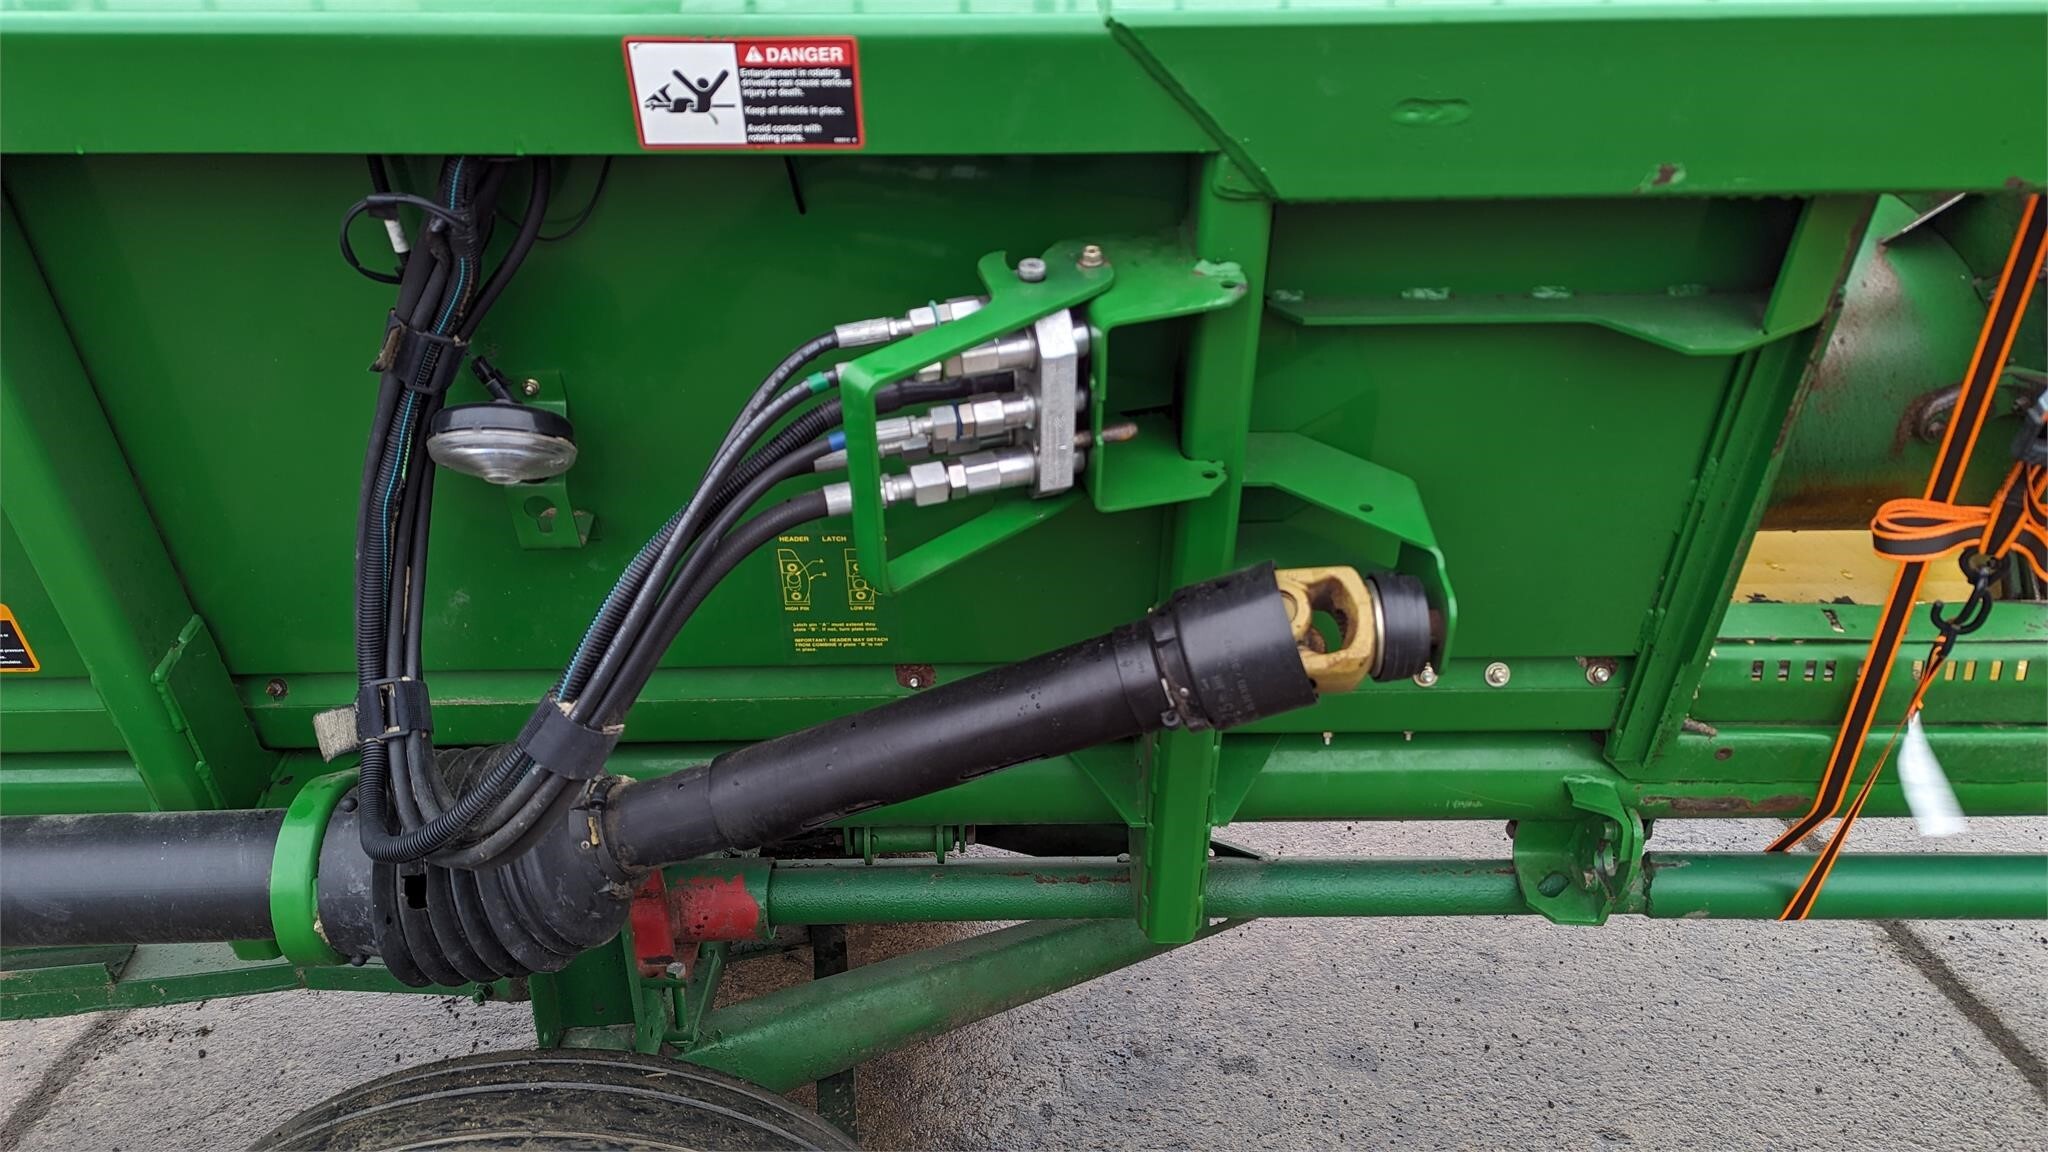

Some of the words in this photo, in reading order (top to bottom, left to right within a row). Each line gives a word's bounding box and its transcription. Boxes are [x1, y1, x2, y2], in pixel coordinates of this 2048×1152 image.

[766, 47, 844, 63] DANGER
[740, 68, 797, 79] Entanglement
[797, 68, 806, 77] in
[807, 68, 841, 79] rotating
[741, 78, 777, 88] driveline
[778, 79, 794, 88] can
[795, 79, 819, 88] cause
[820, 78, 852, 88] serious
[742, 88, 766, 99] injury
[767, 88, 777, 97] or
[778, 87, 805, 97] death.
[744, 105, 767, 117] Keep
[767, 105, 778, 115] all
[779, 105, 808, 115] shields
[809, 105, 818, 115] in
[819, 105, 844, 118] place.
[748, 123, 771, 133] Avoid
[772, 123, 803, 133] contact
[804, 123, 823, 133] with
[748, 133, 781, 144] rotating
[781, 133, 805, 144] parts.
